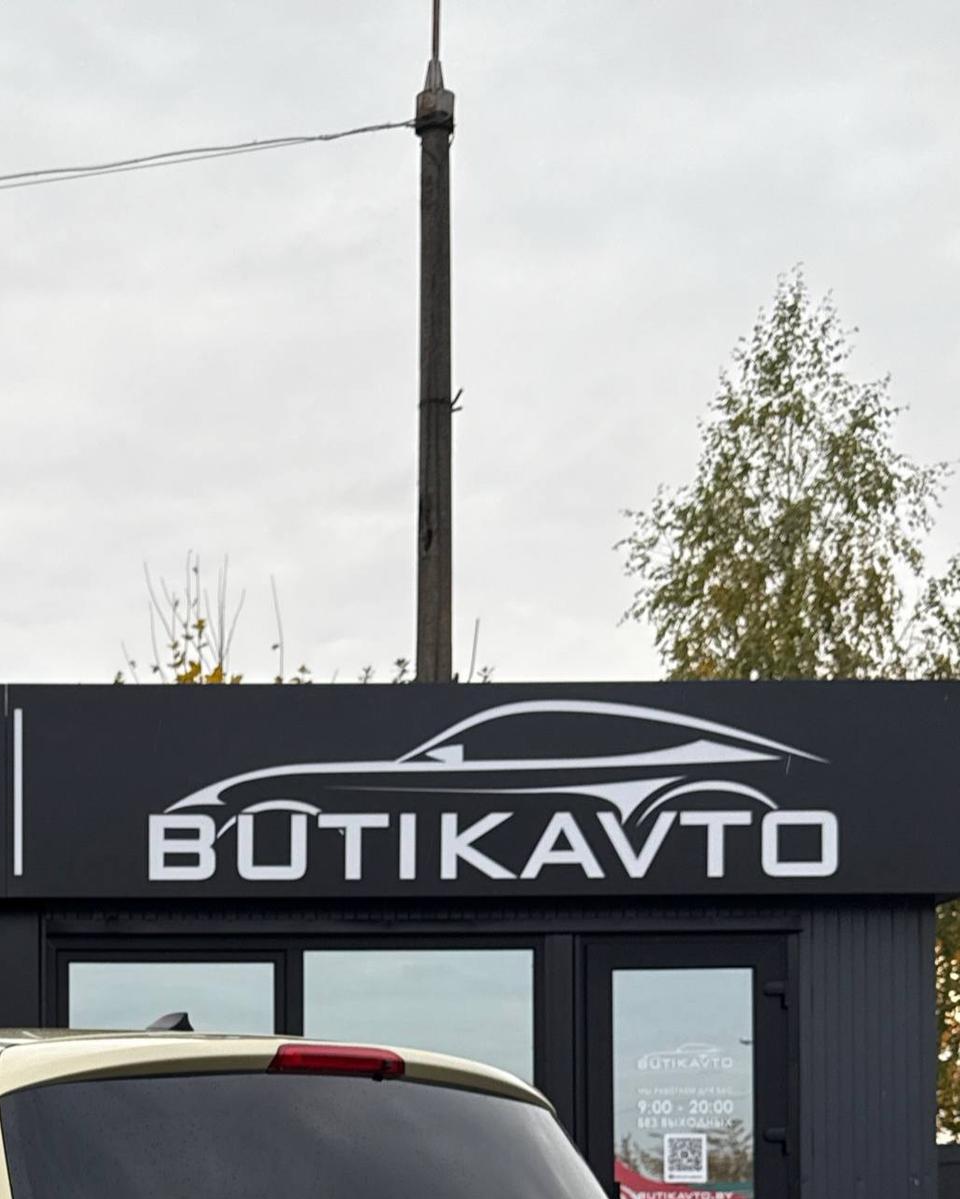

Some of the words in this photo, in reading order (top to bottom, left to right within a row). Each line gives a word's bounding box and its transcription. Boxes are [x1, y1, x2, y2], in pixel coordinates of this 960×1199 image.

[148, 809, 839, 881] BUTIKAVTO
[637, 1057, 733, 1070] BUTIKAVTO
[637, 1099, 672, 1114] 9:00
[689, 1099, 733, 1114] 20:00
